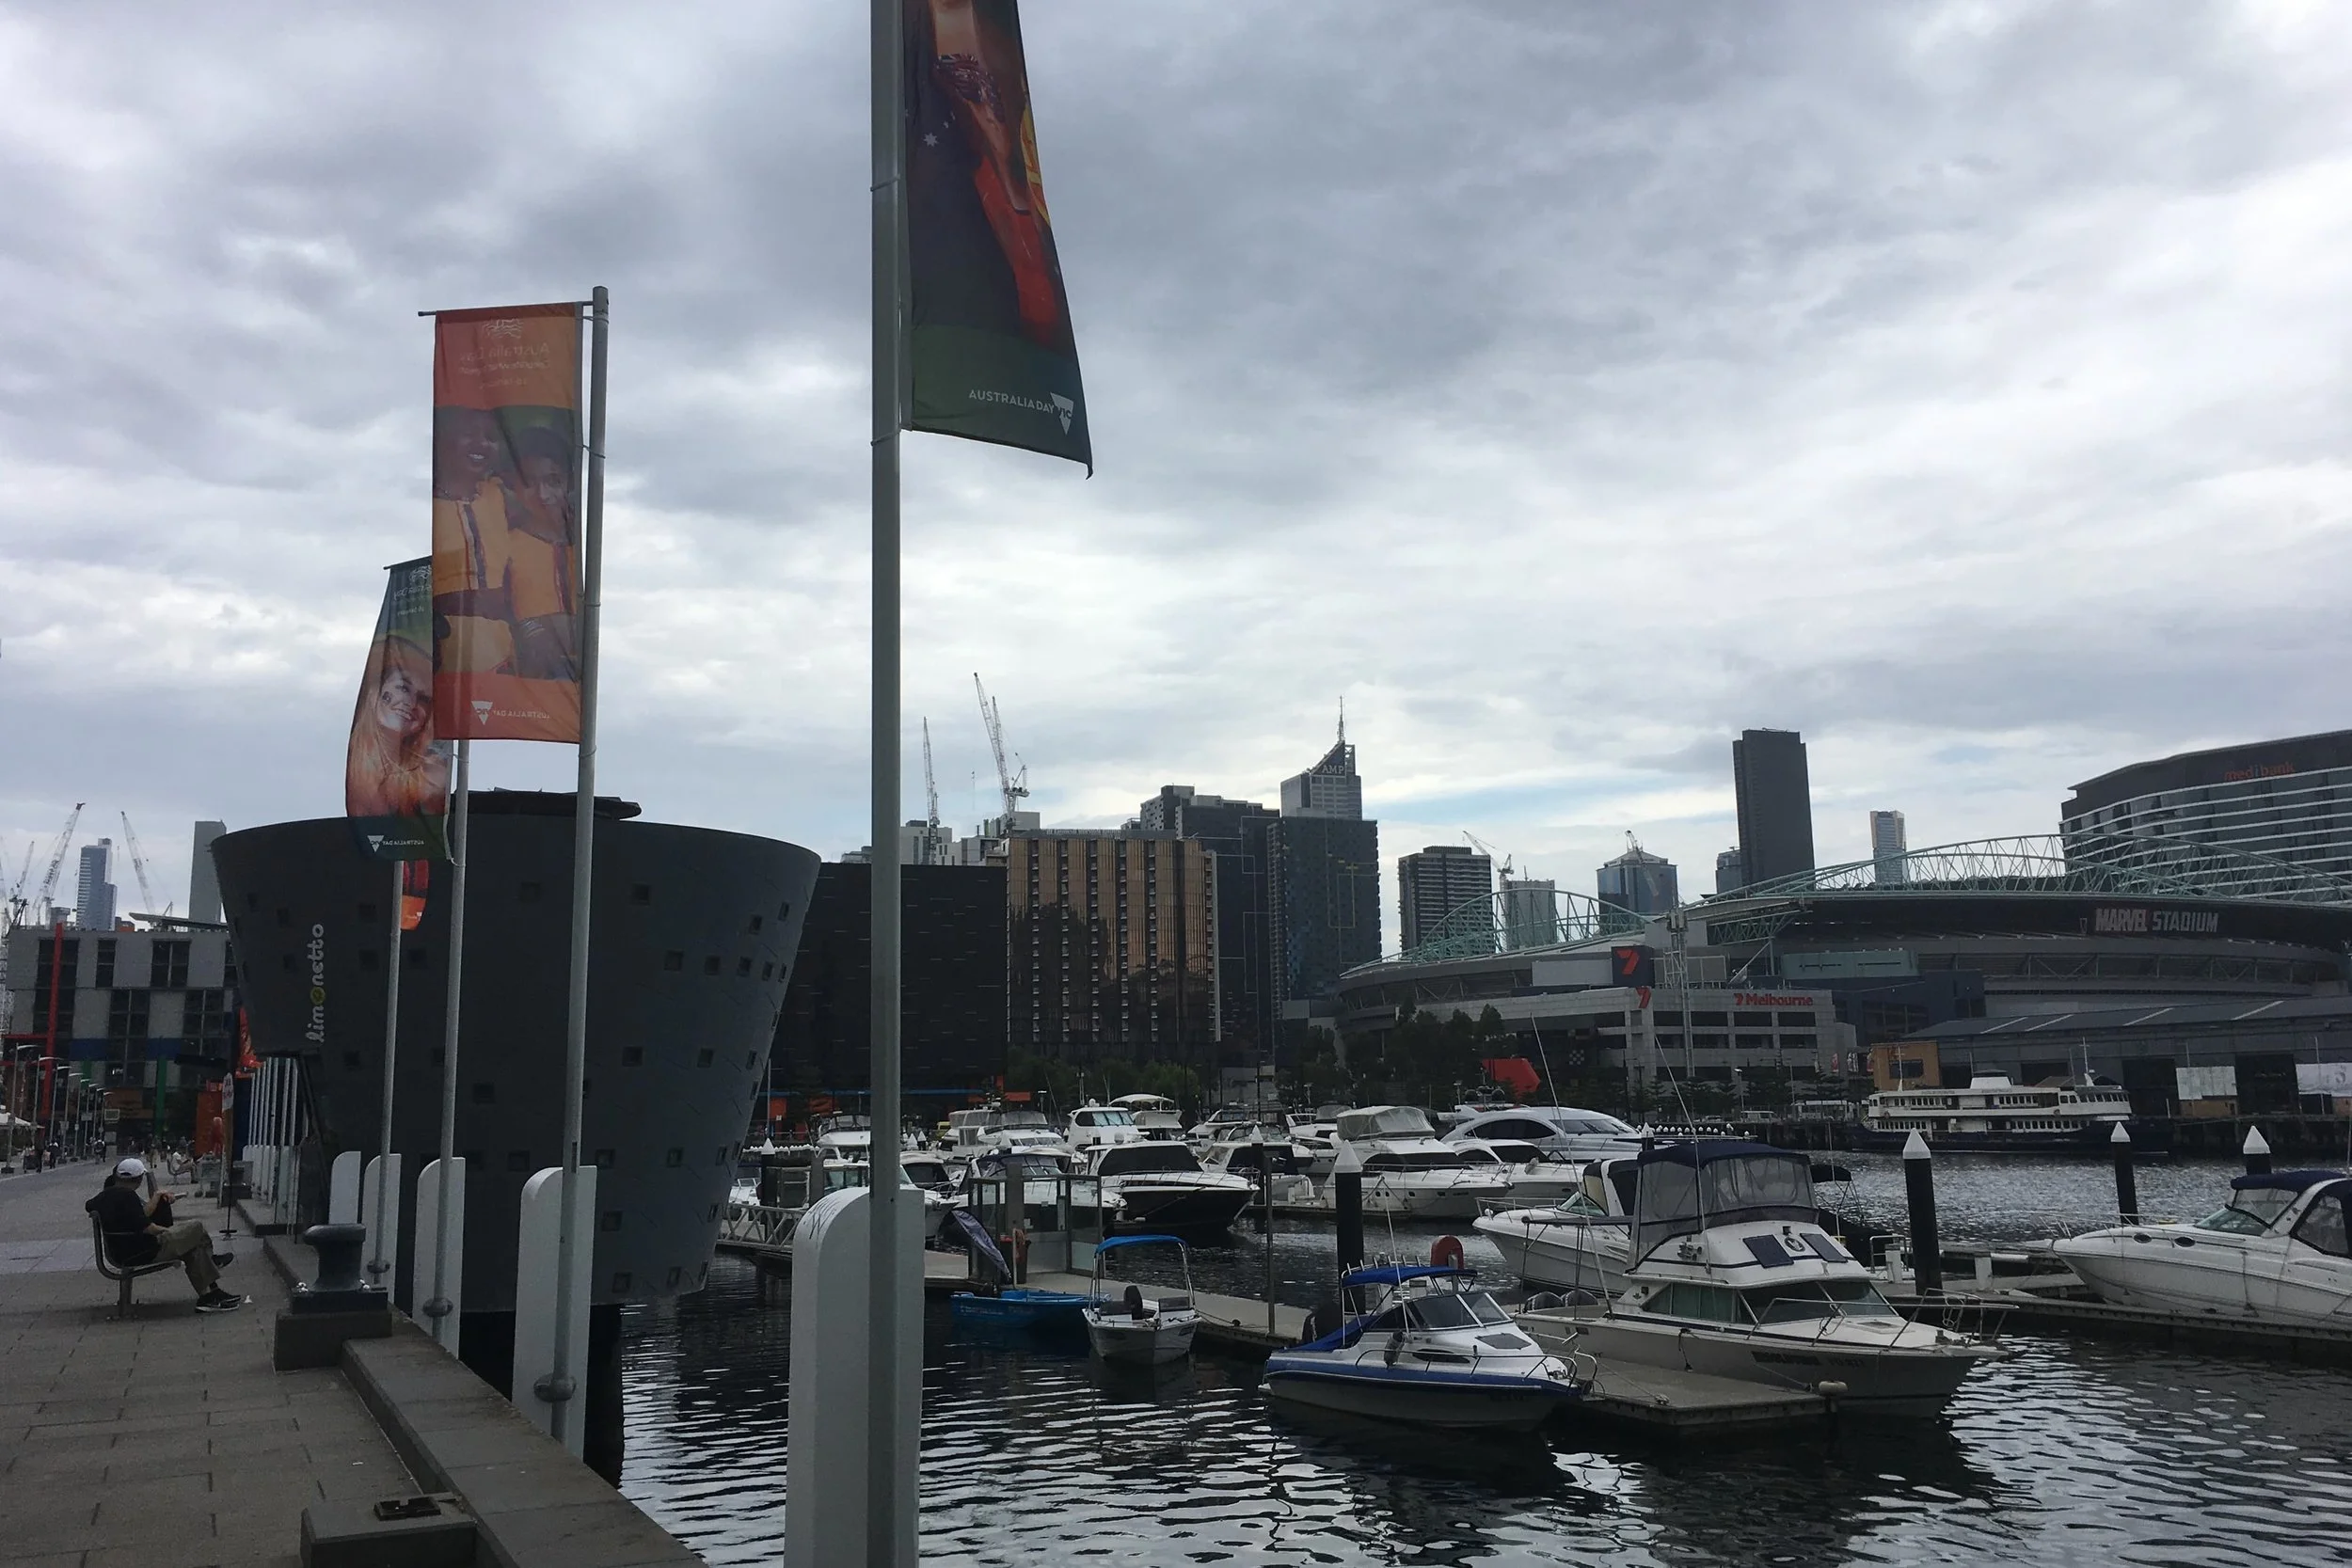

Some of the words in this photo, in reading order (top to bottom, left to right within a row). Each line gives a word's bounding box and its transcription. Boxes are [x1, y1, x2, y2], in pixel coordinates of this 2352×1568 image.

[969, 389, 1035, 409] AUSTRALIA
[1035, 401, 1056, 414] DAY
[1322, 765, 1344, 774] AMP
[2224, 762, 2296, 781] medibank
[2094, 907, 2149, 932] MARVEL
[2152, 911, 2220, 933] STADIUM
[1616, 949, 1639, 974] 7
[305, 924, 326, 1043] limonetto
[1745, 992, 1814, 1006] Melbourne
